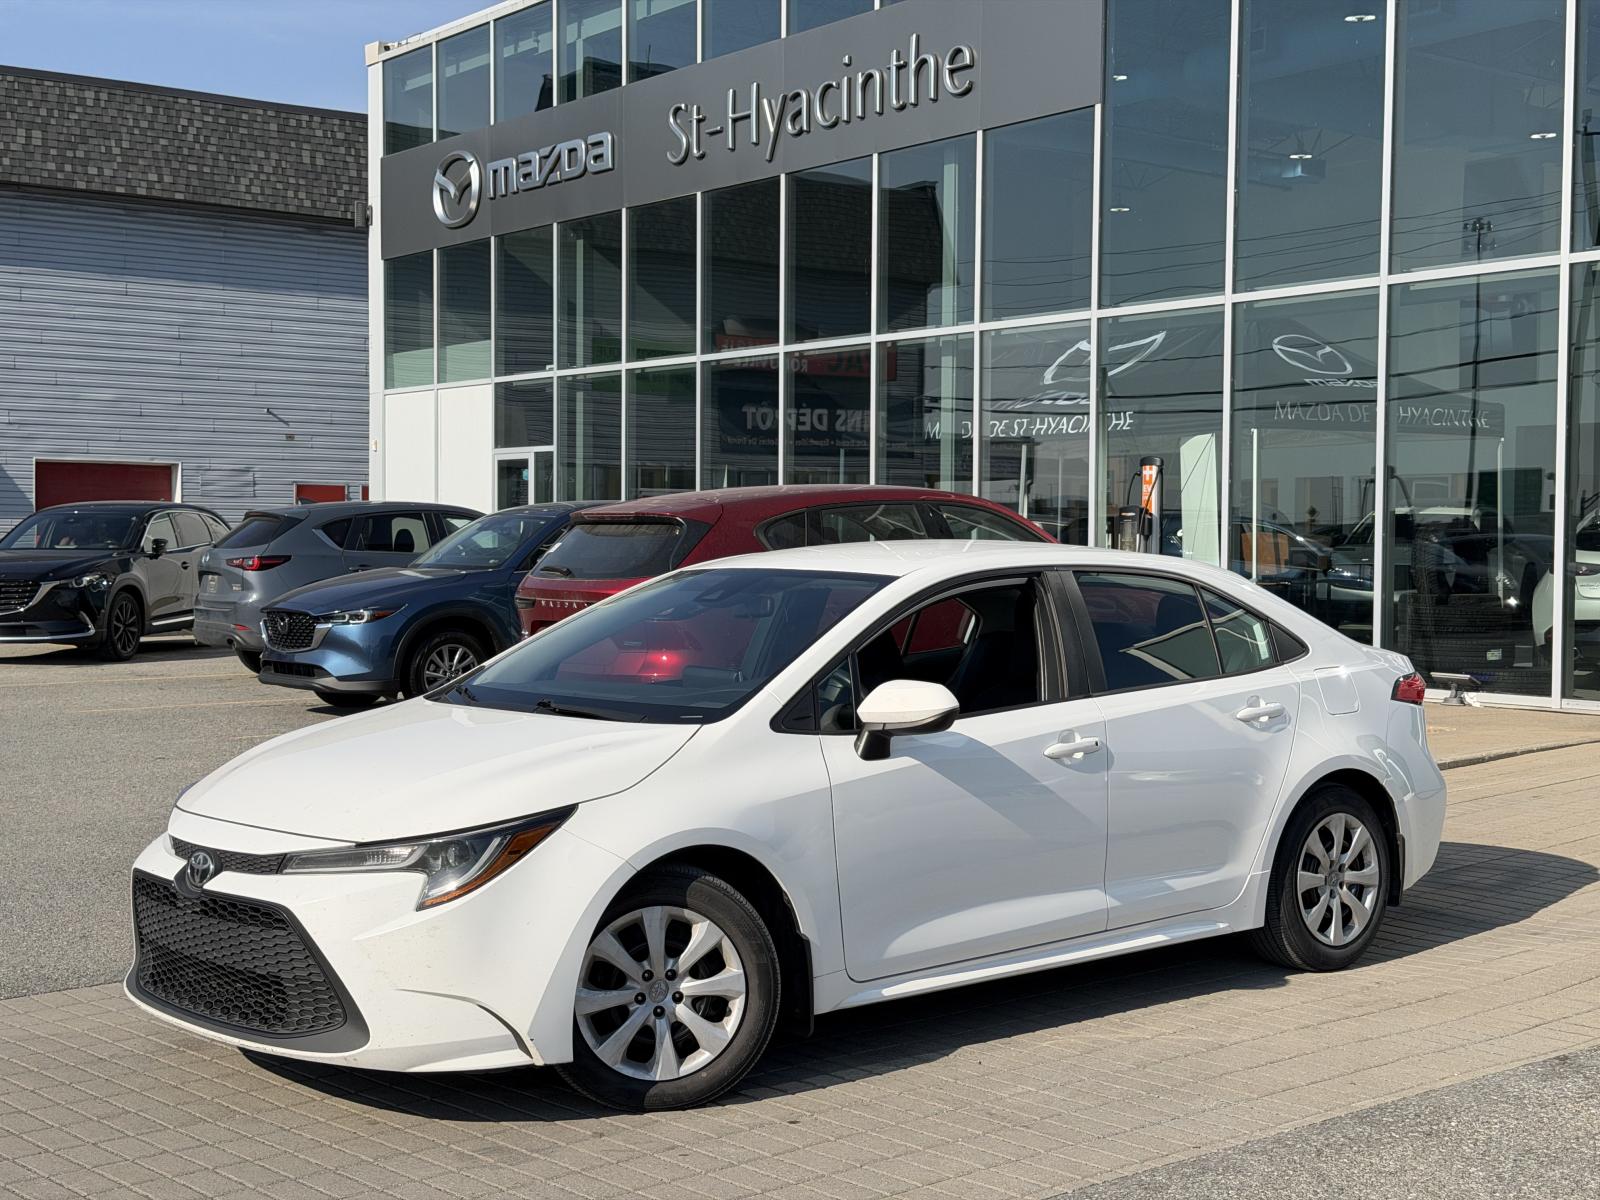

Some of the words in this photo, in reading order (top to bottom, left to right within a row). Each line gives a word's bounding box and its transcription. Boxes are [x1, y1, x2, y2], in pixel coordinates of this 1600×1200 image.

[666, 33, 976, 165] St-Hyacinthe
[487, 131, 615, 200] mazda
[1009, 411, 1135, 437] ST-HYACIHE
[1274, 400, 1344, 422] MAZDA
[1348, 403, 1371, 423] DE
